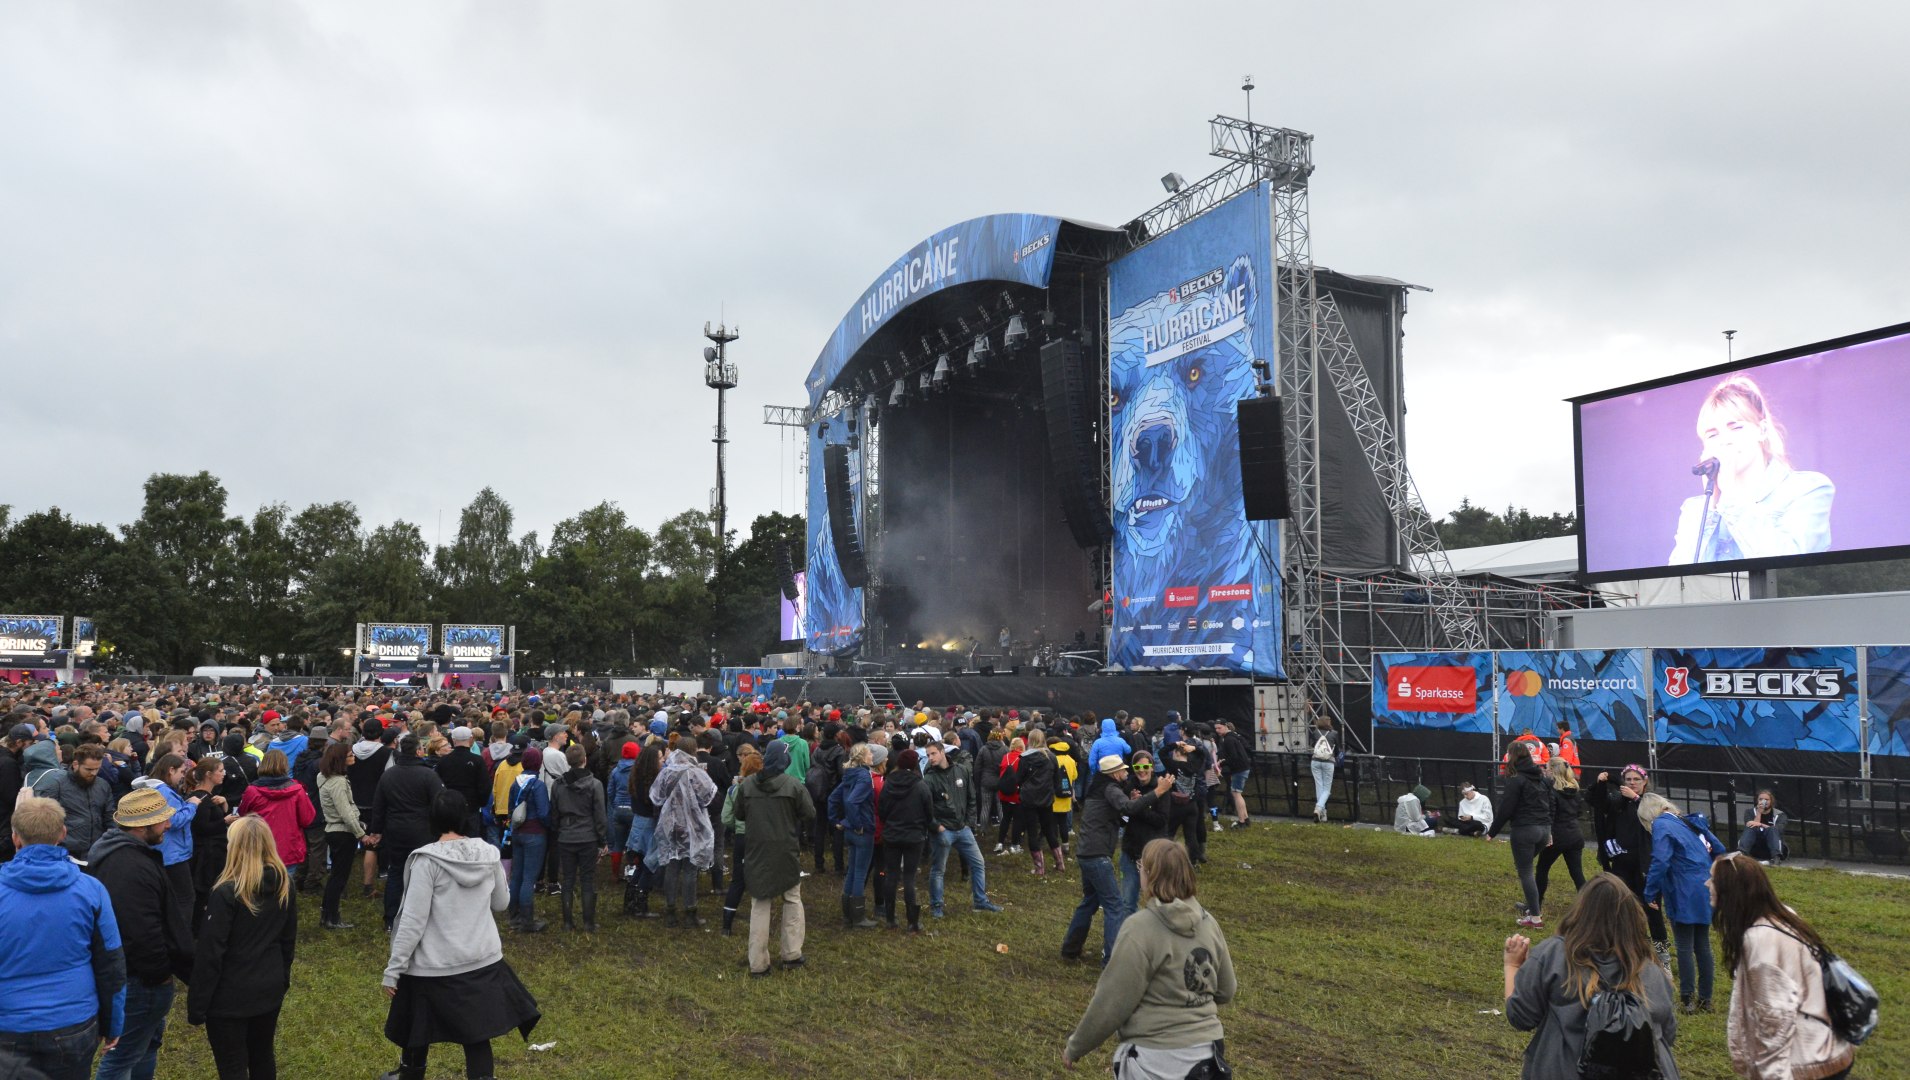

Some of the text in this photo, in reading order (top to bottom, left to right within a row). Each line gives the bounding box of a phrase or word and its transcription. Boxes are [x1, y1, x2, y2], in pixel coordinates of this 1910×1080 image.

[1021, 233, 1050, 258] BECK'S
[861, 236, 959, 335] HURRICANE
[1181, 269, 1223, 298] BECK'S
[1143, 283, 1246, 354] HURRICANE
[1182, 332, 1212, 352] FESTIVAL
[1211, 587, 1251, 599] Firestone
[0, 638, 47, 651] DRINKS
[379, 645, 420, 656] DRINKS
[453, 645, 493, 657] DRINKS
[1152, 644, 1222, 655] HURRICANE FESTIVAL 2018
[1548, 676, 1638, 690] mastercard
[1706, 670, 1841, 697] BECK'S
[1415, 686, 1464, 701] Sparkasse
